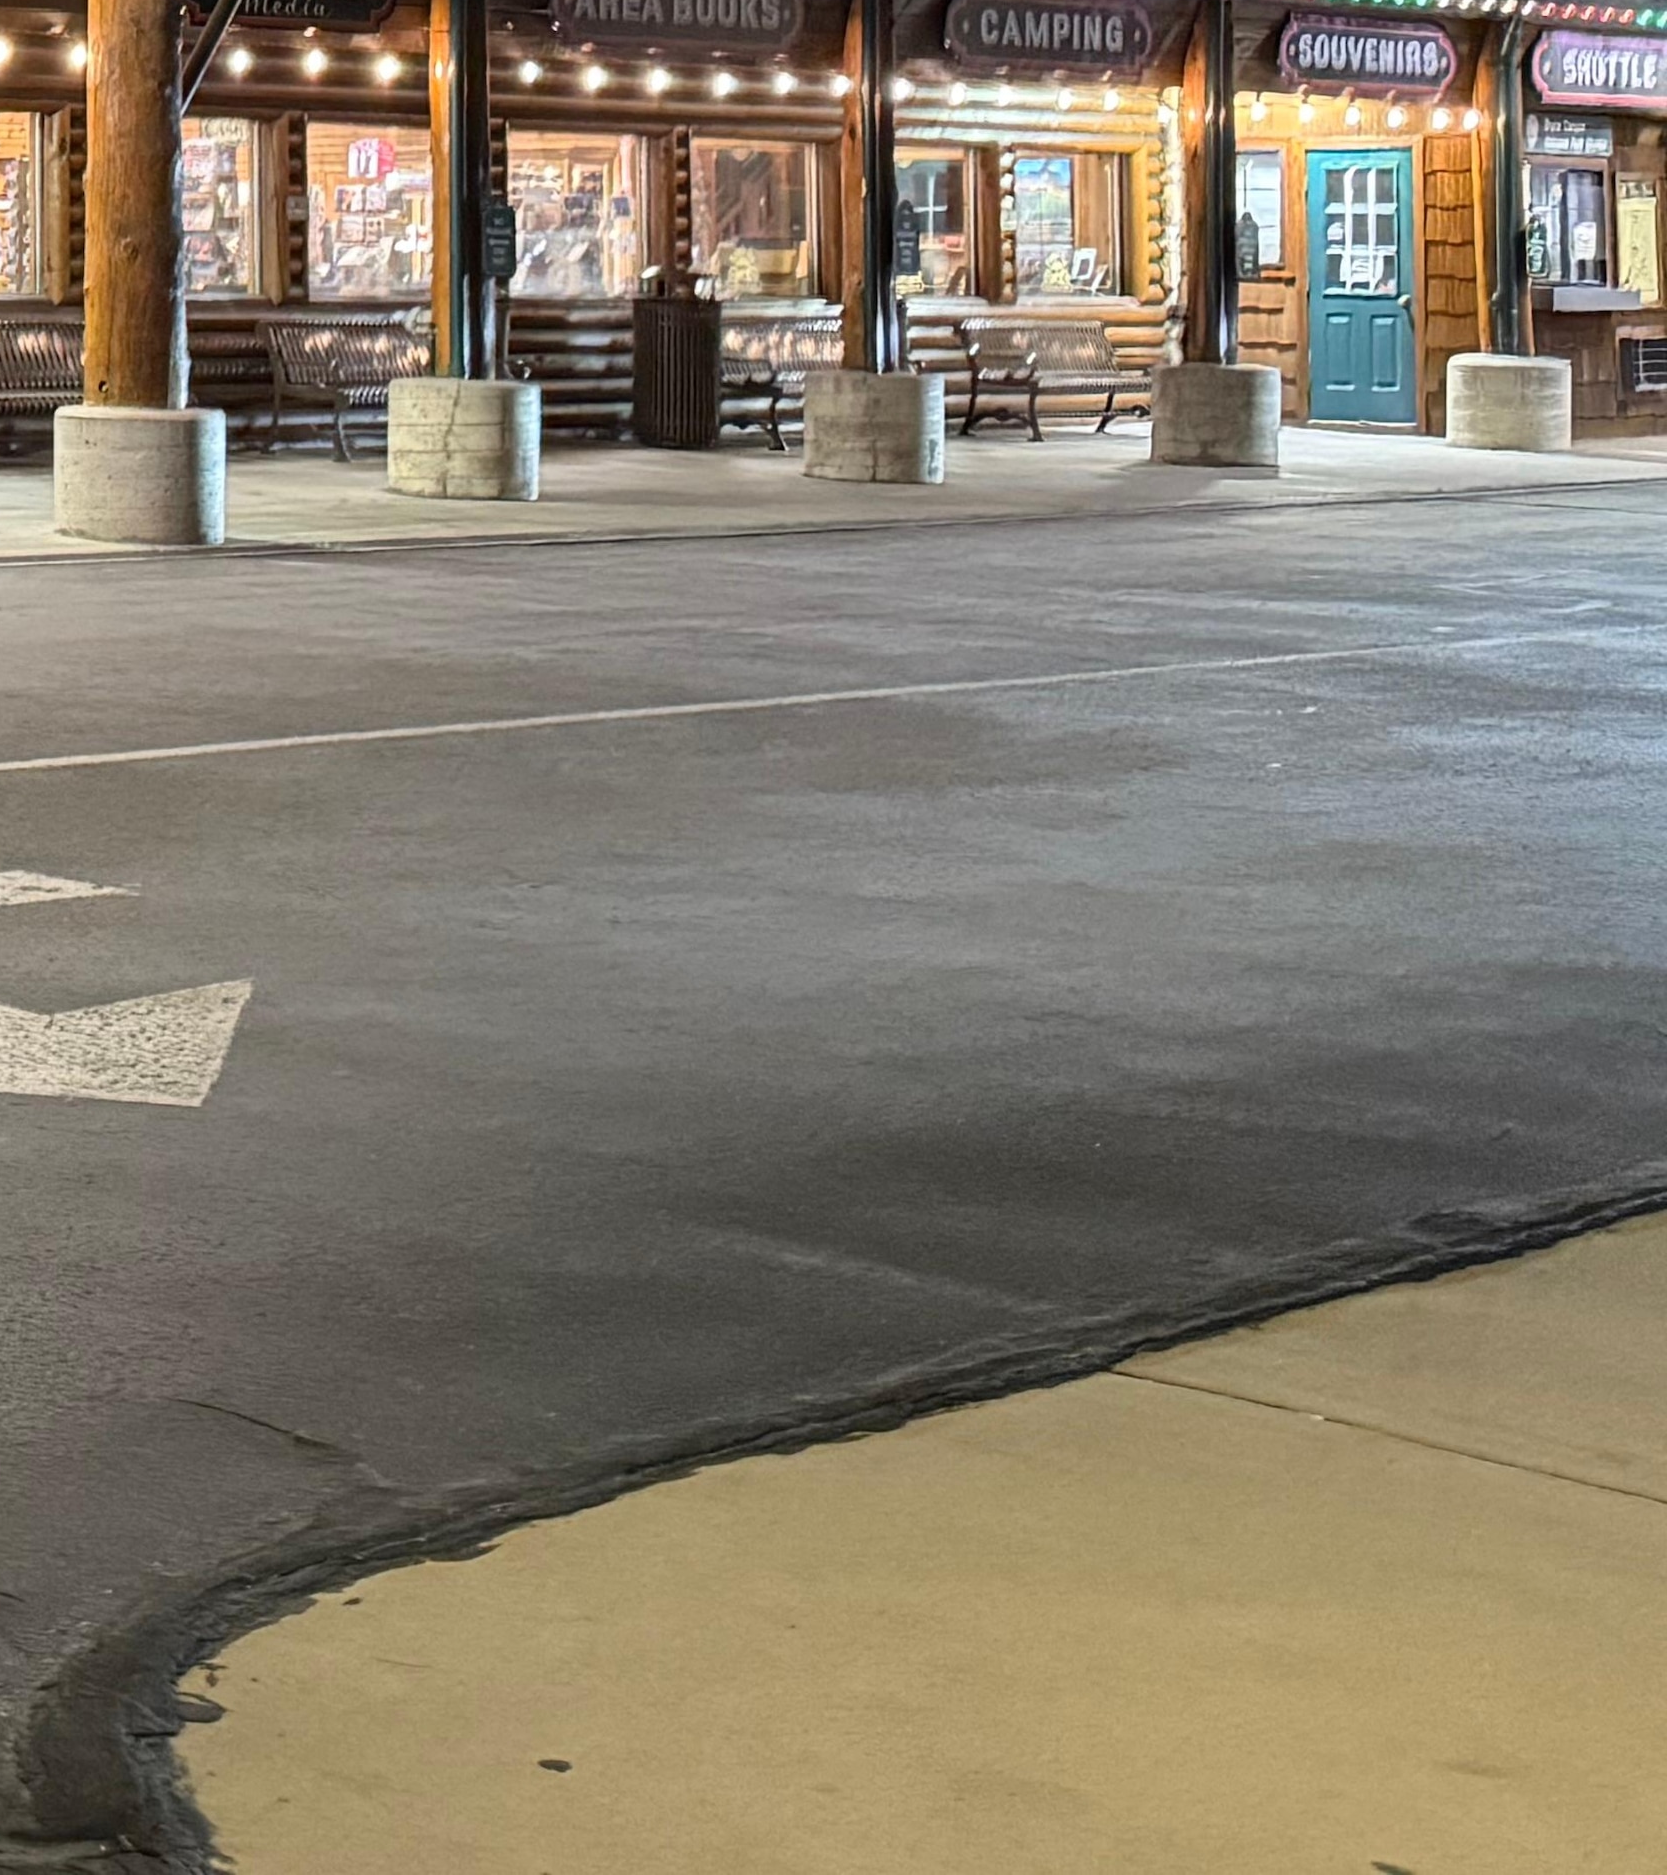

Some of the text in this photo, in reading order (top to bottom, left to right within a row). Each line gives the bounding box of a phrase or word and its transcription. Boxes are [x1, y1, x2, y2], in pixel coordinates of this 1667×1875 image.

[980, 8, 1124, 53] CAMPING
[1298, 33, 1440, 76] SOUVENIRS
[1562, 47, 1658, 90] SHUTTLE
